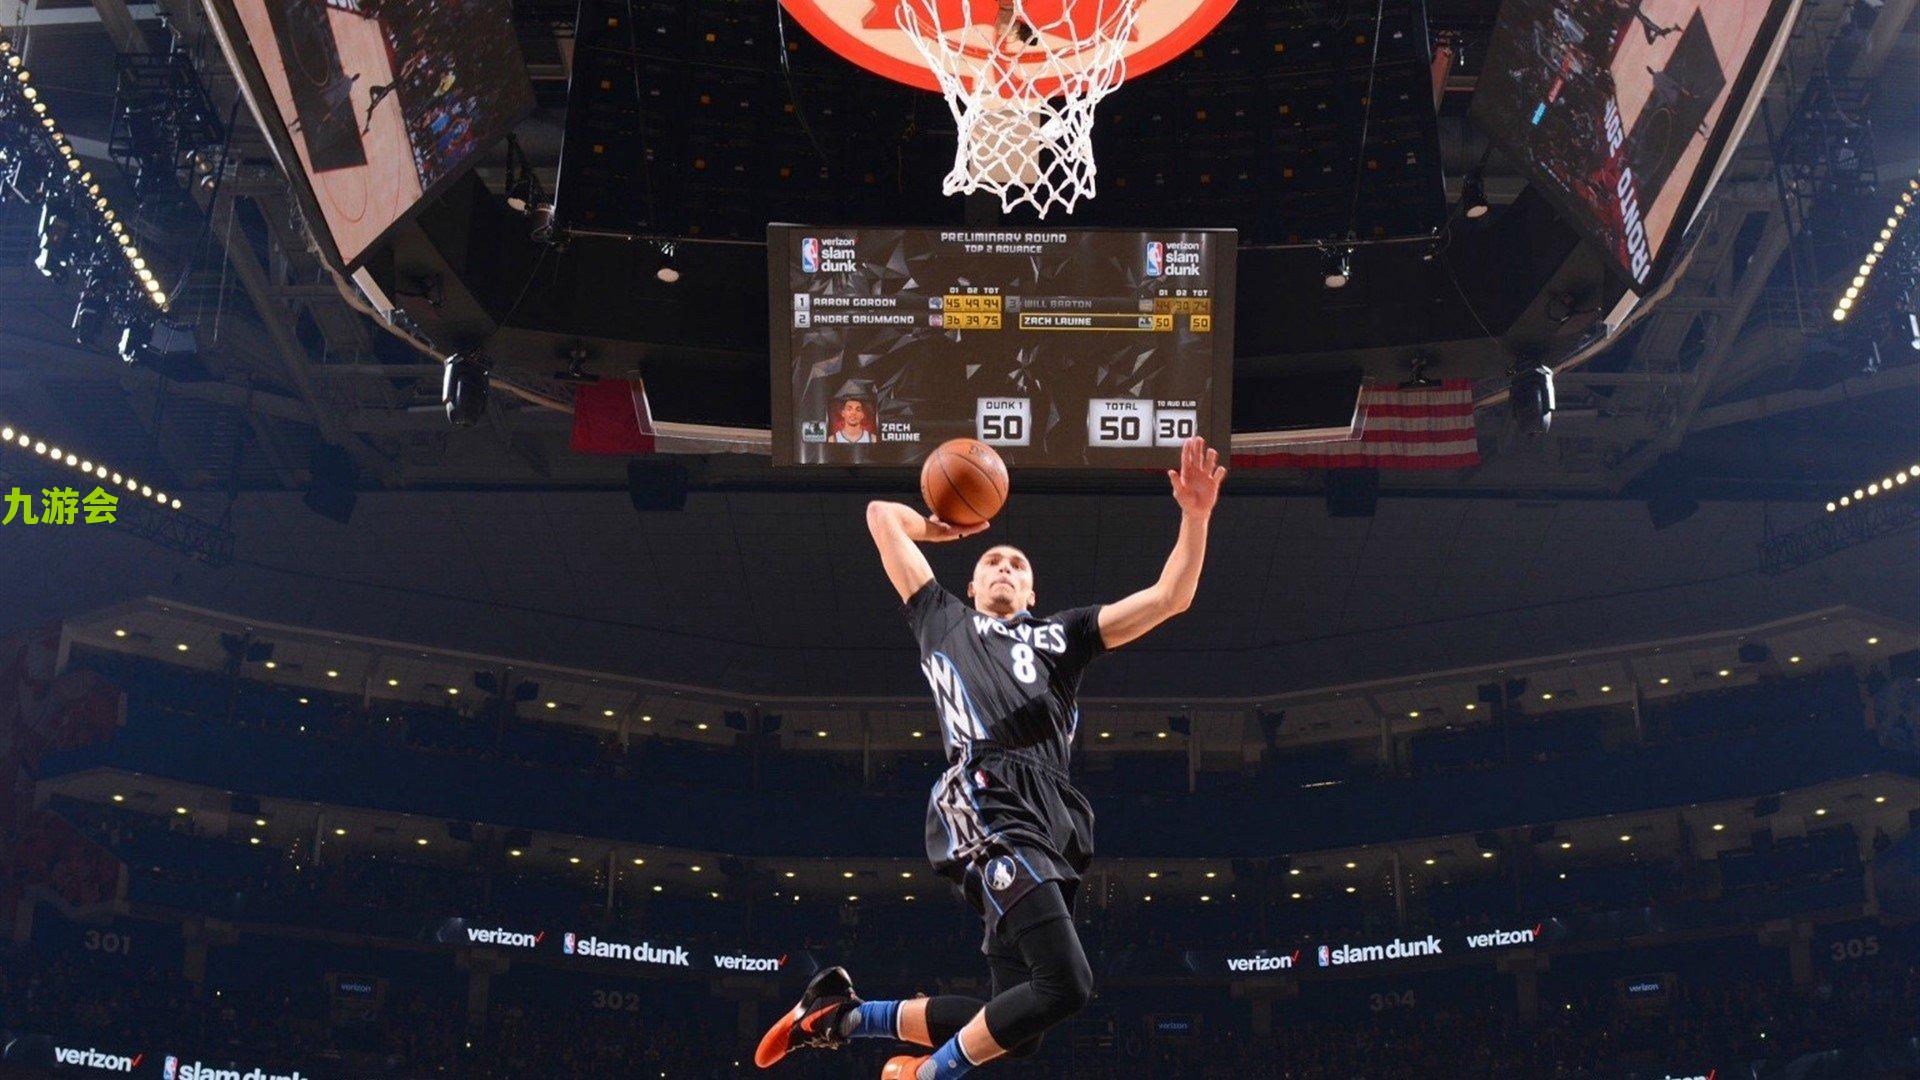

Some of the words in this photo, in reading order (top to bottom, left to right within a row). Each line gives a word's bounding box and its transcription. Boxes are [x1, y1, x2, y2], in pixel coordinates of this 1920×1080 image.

[821, 237, 855, 246] verizon
[940, 232, 1021, 242] PRELIMINARY
[1025, 233, 1067, 243] ROUND
[965, 244, 984, 253] TOP
[986, 245, 993, 253] 2
[996, 245, 1043, 253] ADVANCE
[1166, 241, 1200, 250] verizon
[821, 247, 856, 259] slam
[1165, 250, 1200, 263] slam
[821, 259, 857, 272] dunk
[1165, 263, 1200, 275] dunk
[800, 297, 805, 306] 1
[813, 298, 850, 306] AARON
[853, 298, 897, 307] GORDON
[945, 299, 960, 308] 45
[965, 299, 980, 308] 49
[984, 299, 999, 308] 94
[799, 315, 806, 324] 2
[813, 315, 850, 324] ANDRE
[852, 315, 915, 324] DRUMMOND
[966, 316, 980, 325] 39
[984, 316, 999, 325] 75
[1024, 317, 1052, 325] ZACH
[1055, 317, 1092, 326] LAVINE
[1156, 317, 1170, 328] 50
[1193, 317, 1208, 328] 50
[986, 401, 1015, 409] DUNK
[1018, 401, 1023, 409] 1
[1105, 402, 1138, 411] TOTAL
[881, 423, 911, 432] ZACH
[983, 415, 1023, 440] 50
[1100, 416, 1140, 441] 50
[1159, 418, 1193, 439] 30
[881, 432, 920, 441] LAVINE
[1011, 643, 1037, 684] 8
[83, 929, 131, 955] 301
[467, 927, 535, 948] verizon
[1466, 927, 1534, 948] verizon
[576, 937, 631, 961] slam
[633, 942, 690, 966] dunk
[1331, 944, 1384, 966] slam
[1385, 935, 1442, 960] dunk
[1829, 934, 1879, 961] 305
[713, 954, 779, 971] verizon
[1227, 955, 1292, 971] verizon
[341, 982, 372, 993] verizon
[1628, 982, 1660, 993] verizon
[593, 989, 639, 1012] 302
[1369, 990, 1416, 1011] 304
[1158, 1021, 1189, 1031] verizon
[54, 1047, 132, 1072] verizon
